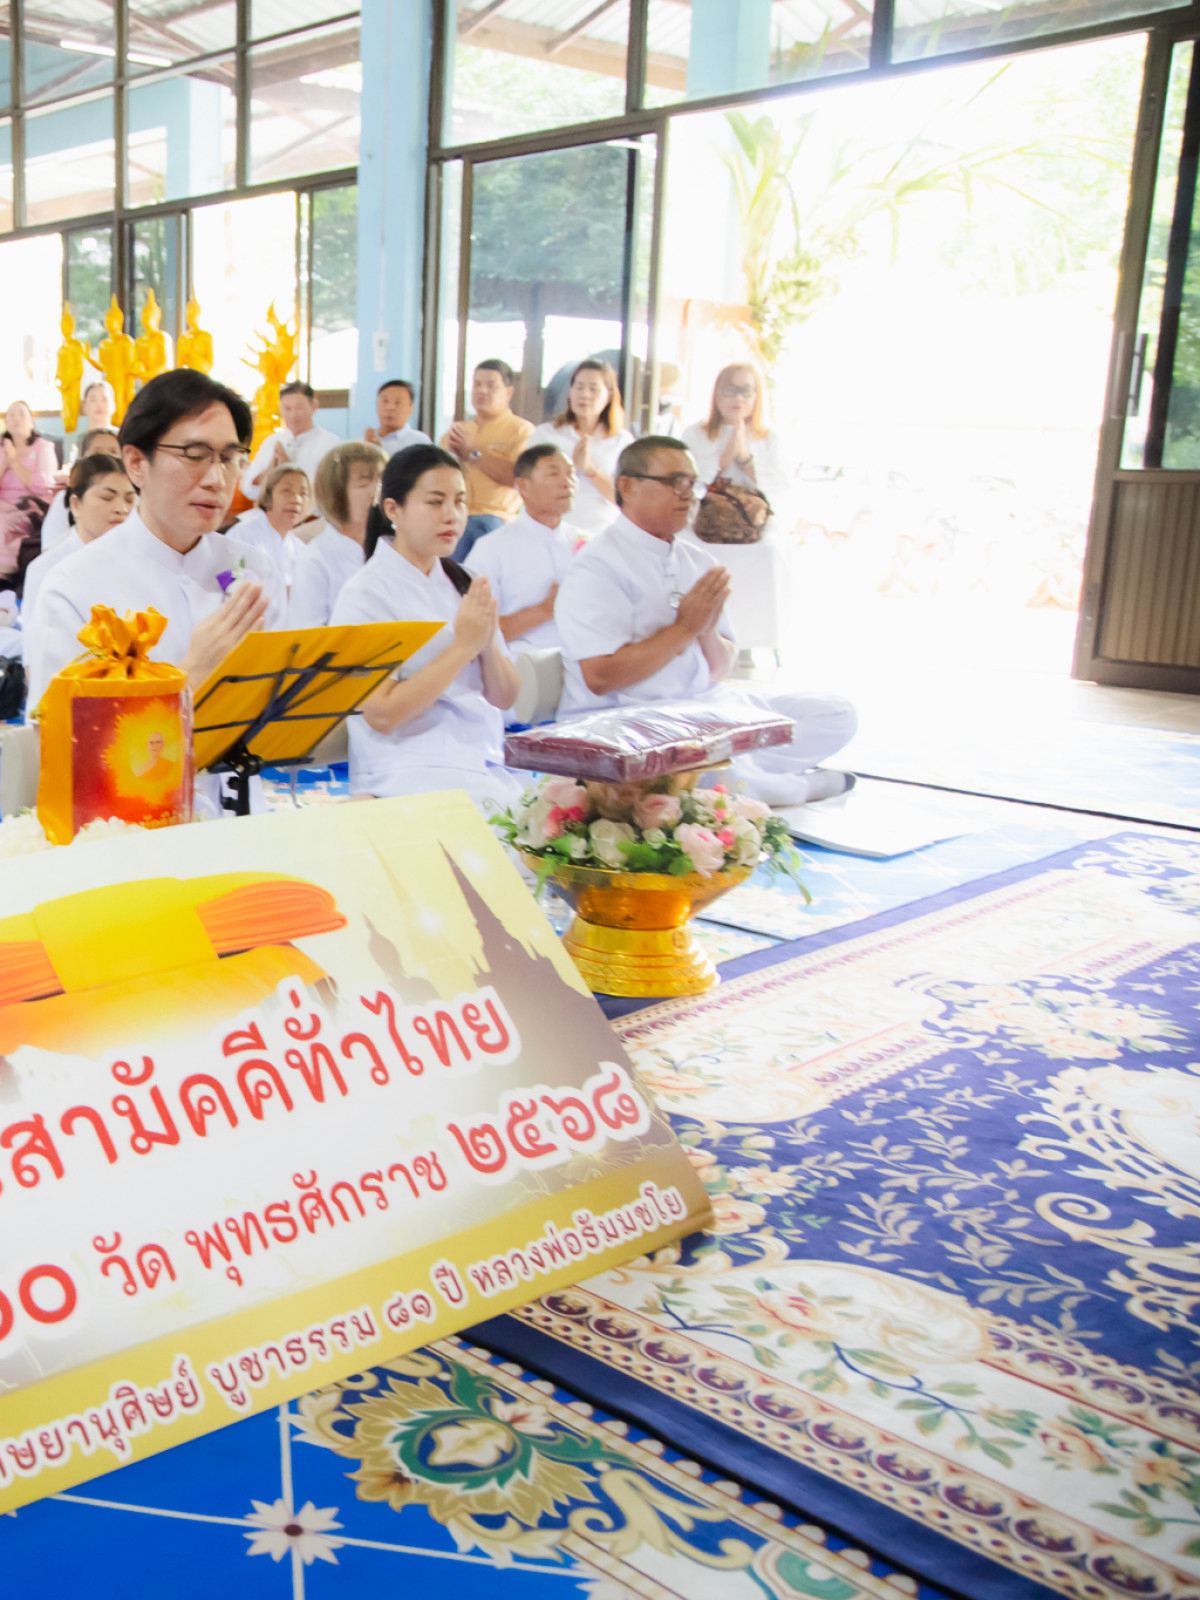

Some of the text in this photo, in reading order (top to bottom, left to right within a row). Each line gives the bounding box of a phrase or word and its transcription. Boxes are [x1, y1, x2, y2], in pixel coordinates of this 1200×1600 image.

[92, 1231, 178, 1297] วัด
[184, 1151, 449, 1288] พุทธศักราช
[447, 1072, 641, 1176] ๒๕๖๘
[211, 1311, 377, 1407] บูชาธรรม
[388, 1294, 432, 1327] ๘๑
[435, 1264, 464, 1303] ปี
[471, 1186, 682, 1292] หลวงพ่อธัมมชโย
